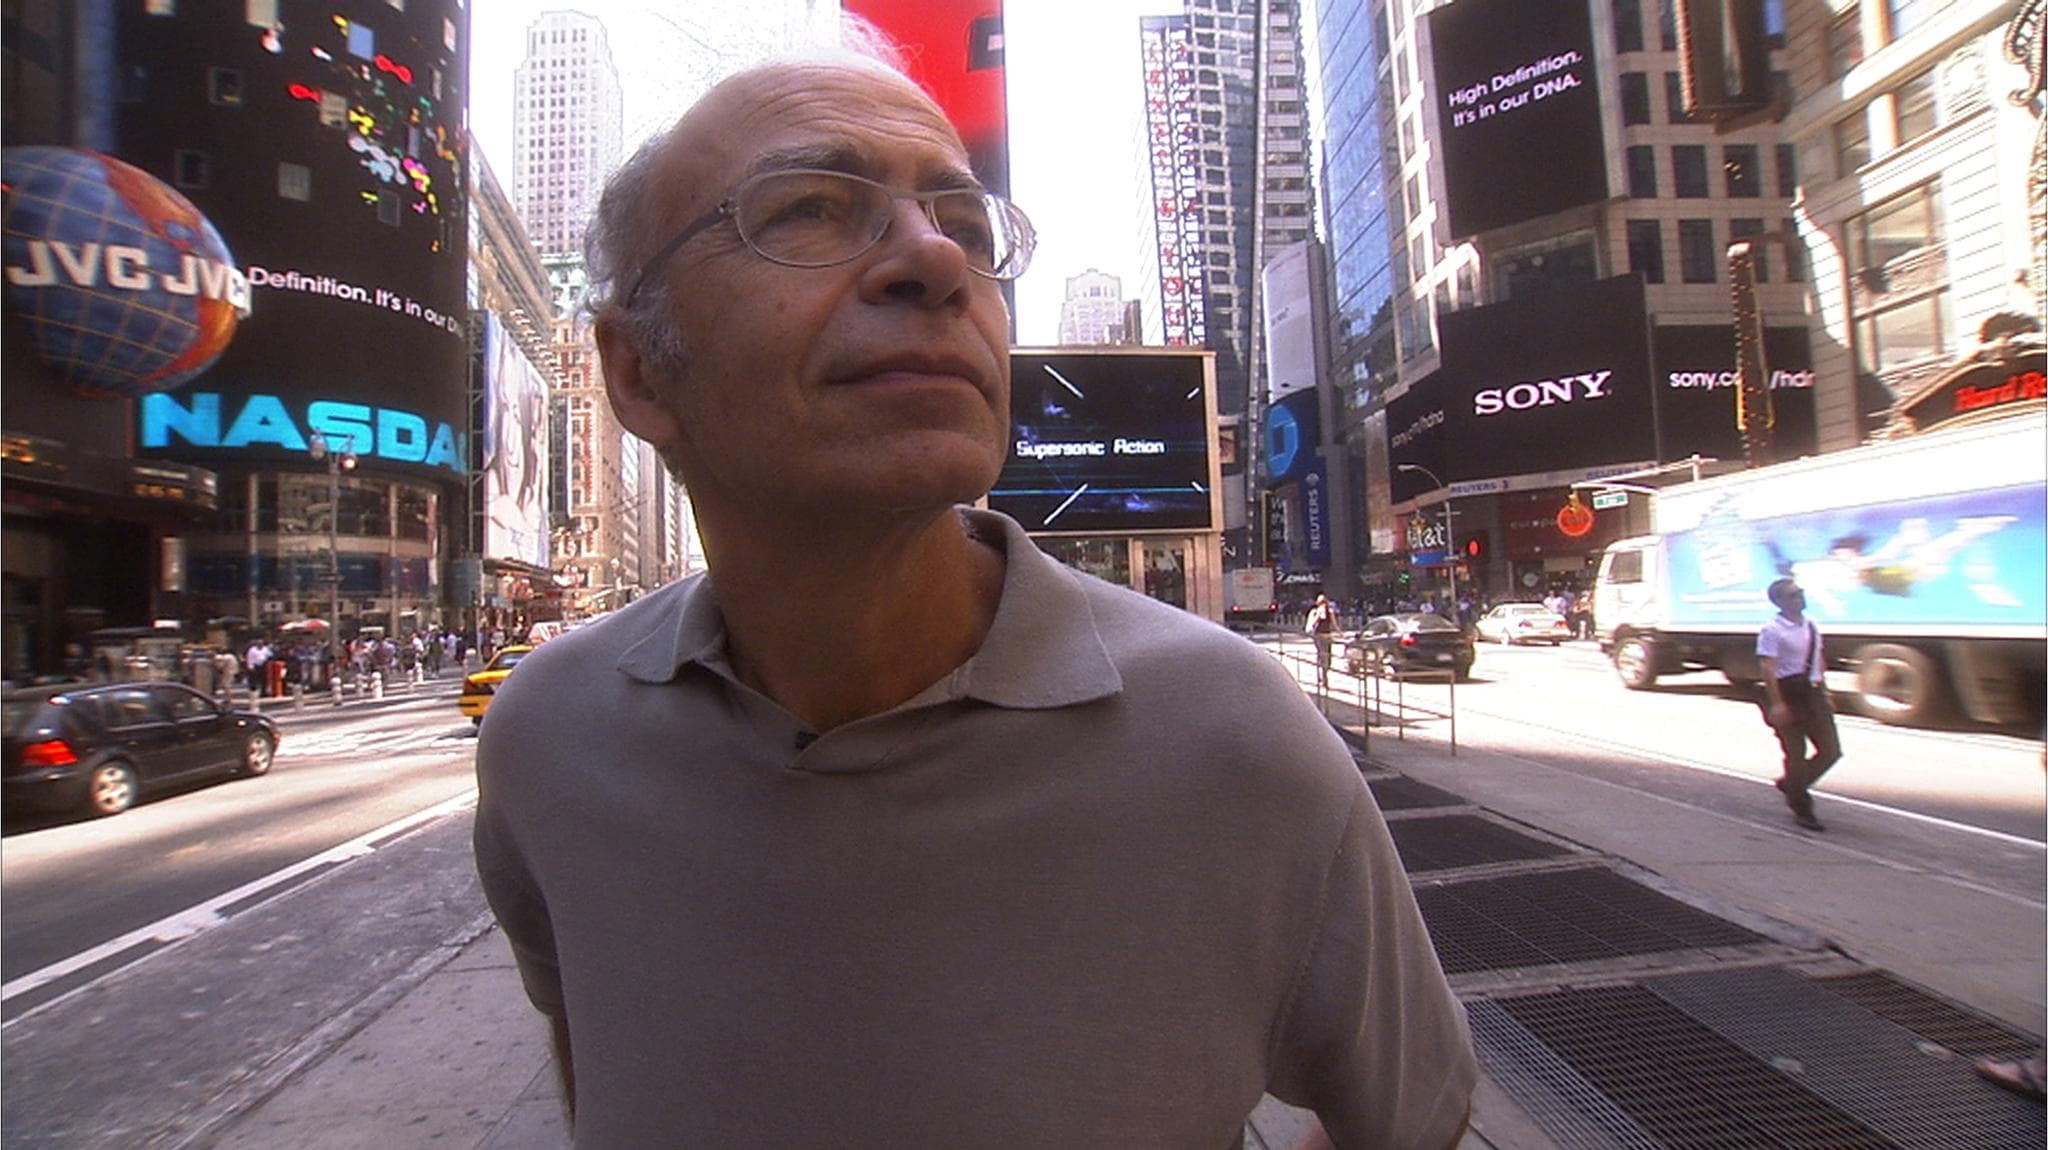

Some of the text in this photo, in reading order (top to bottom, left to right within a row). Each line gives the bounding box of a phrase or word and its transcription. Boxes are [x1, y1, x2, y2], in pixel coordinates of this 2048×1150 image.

[1449, 50, 1582, 107] High Definition.
[1453, 73, 1582, 127] It's in our DNA.
[5, 240, 250, 314] JVC JVC
[248, 266, 372, 304] Definition.
[376, 289, 402, 312] It's
[405, 299, 421, 318] in
[424, 308, 446, 330] our
[1474, 371, 1611, 416] SONY
[1016, 438, 1165, 459] Supersonic Action
[1307, 488, 1321, 549] REUTERS
